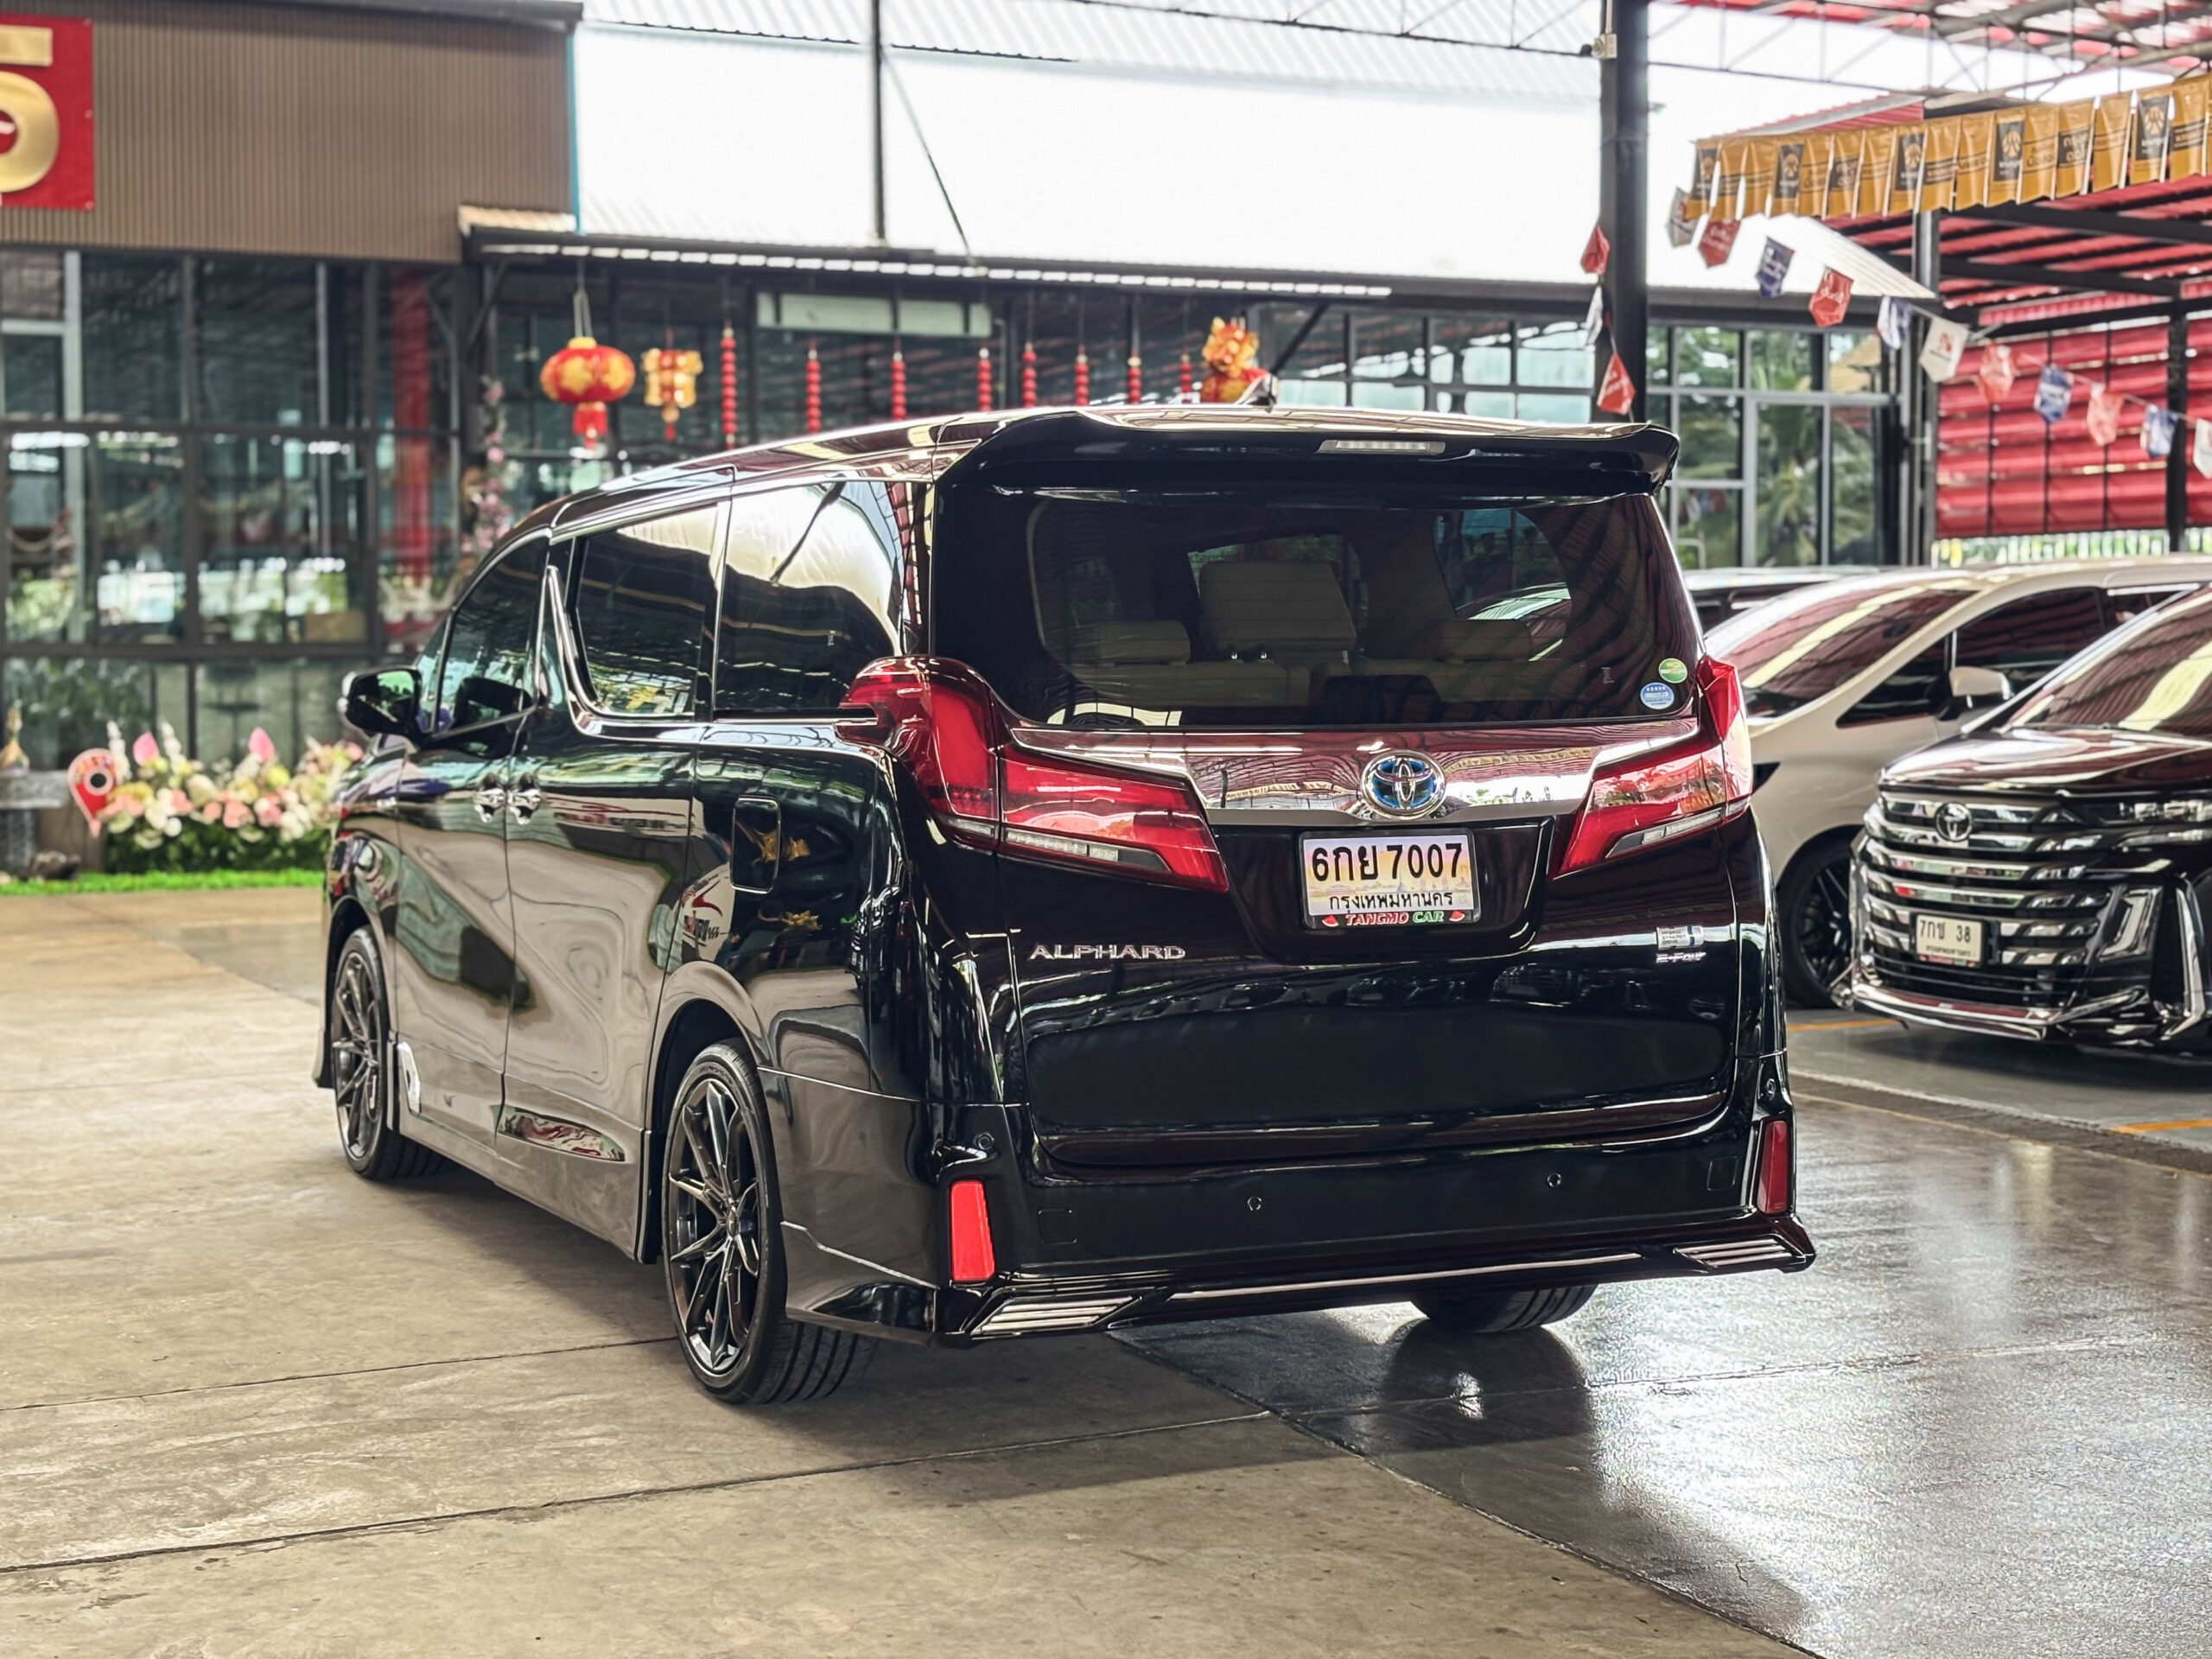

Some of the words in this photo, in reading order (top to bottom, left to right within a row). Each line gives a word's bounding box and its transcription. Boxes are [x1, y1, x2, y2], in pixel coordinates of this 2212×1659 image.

[1312, 846, 1379, 881] 6กย
[1386, 843, 1463, 880] 7007
[1330, 892, 1453, 913] กรุงเทพมหานคร
[1344, 912, 1409, 926] TANGMO
[1412, 911, 1444, 923] CAR
[1955, 925, 1972, 944] 38
[1029, 944, 1186, 960] ALPHARD
